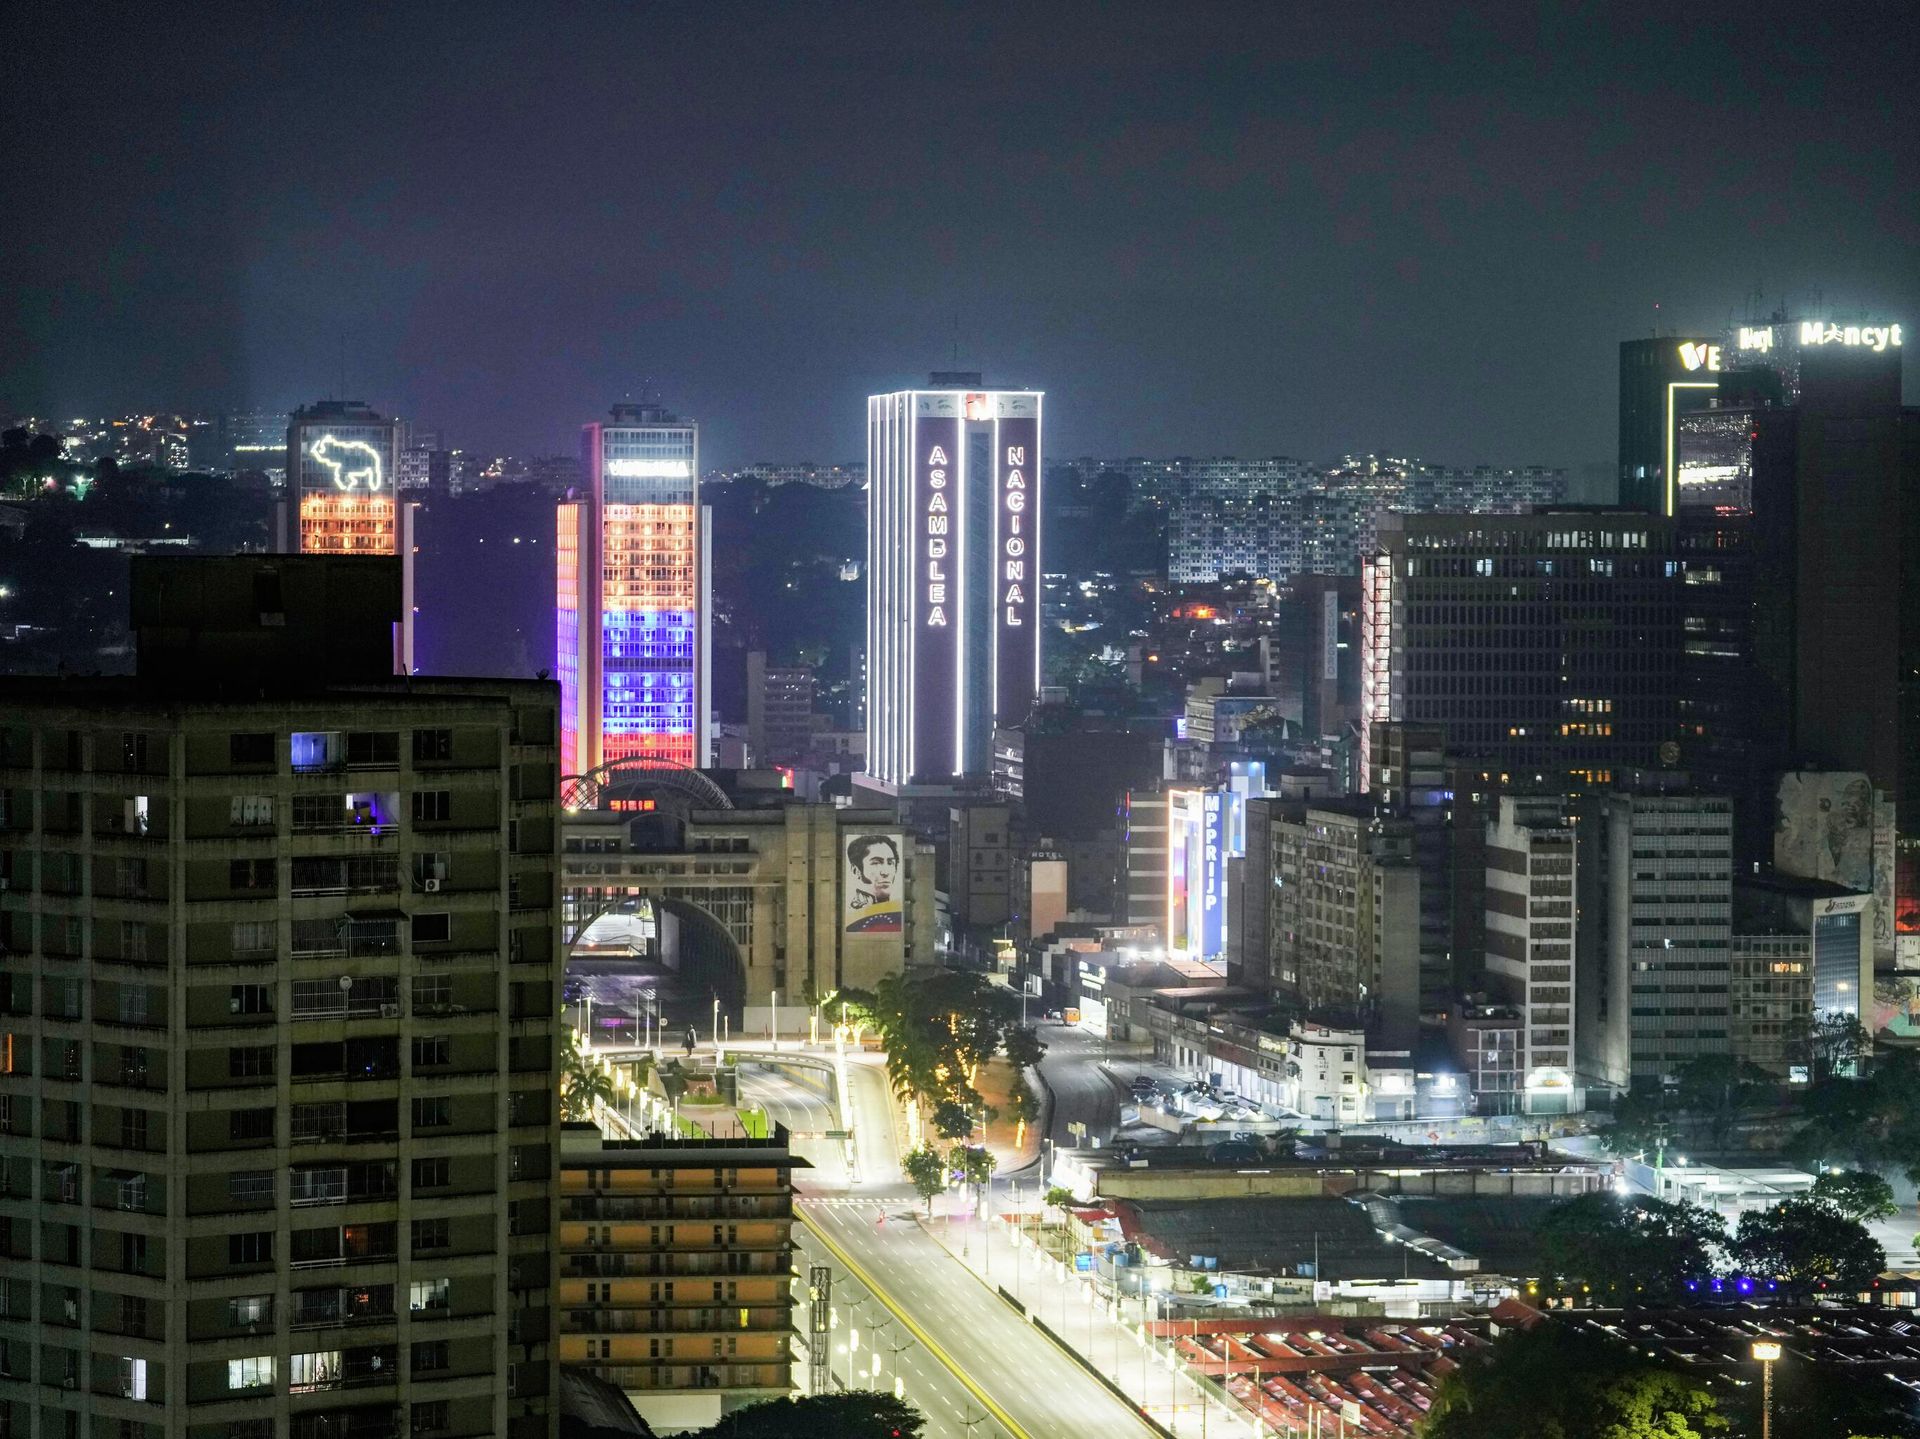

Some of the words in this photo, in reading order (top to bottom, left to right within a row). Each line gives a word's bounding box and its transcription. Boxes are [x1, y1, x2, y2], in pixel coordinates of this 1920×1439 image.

[928, 445, 948, 627] ASAMBLEA
[1006, 446, 1026, 626] NACIONAL
[1204, 795, 1219, 911] MPPRIJP
